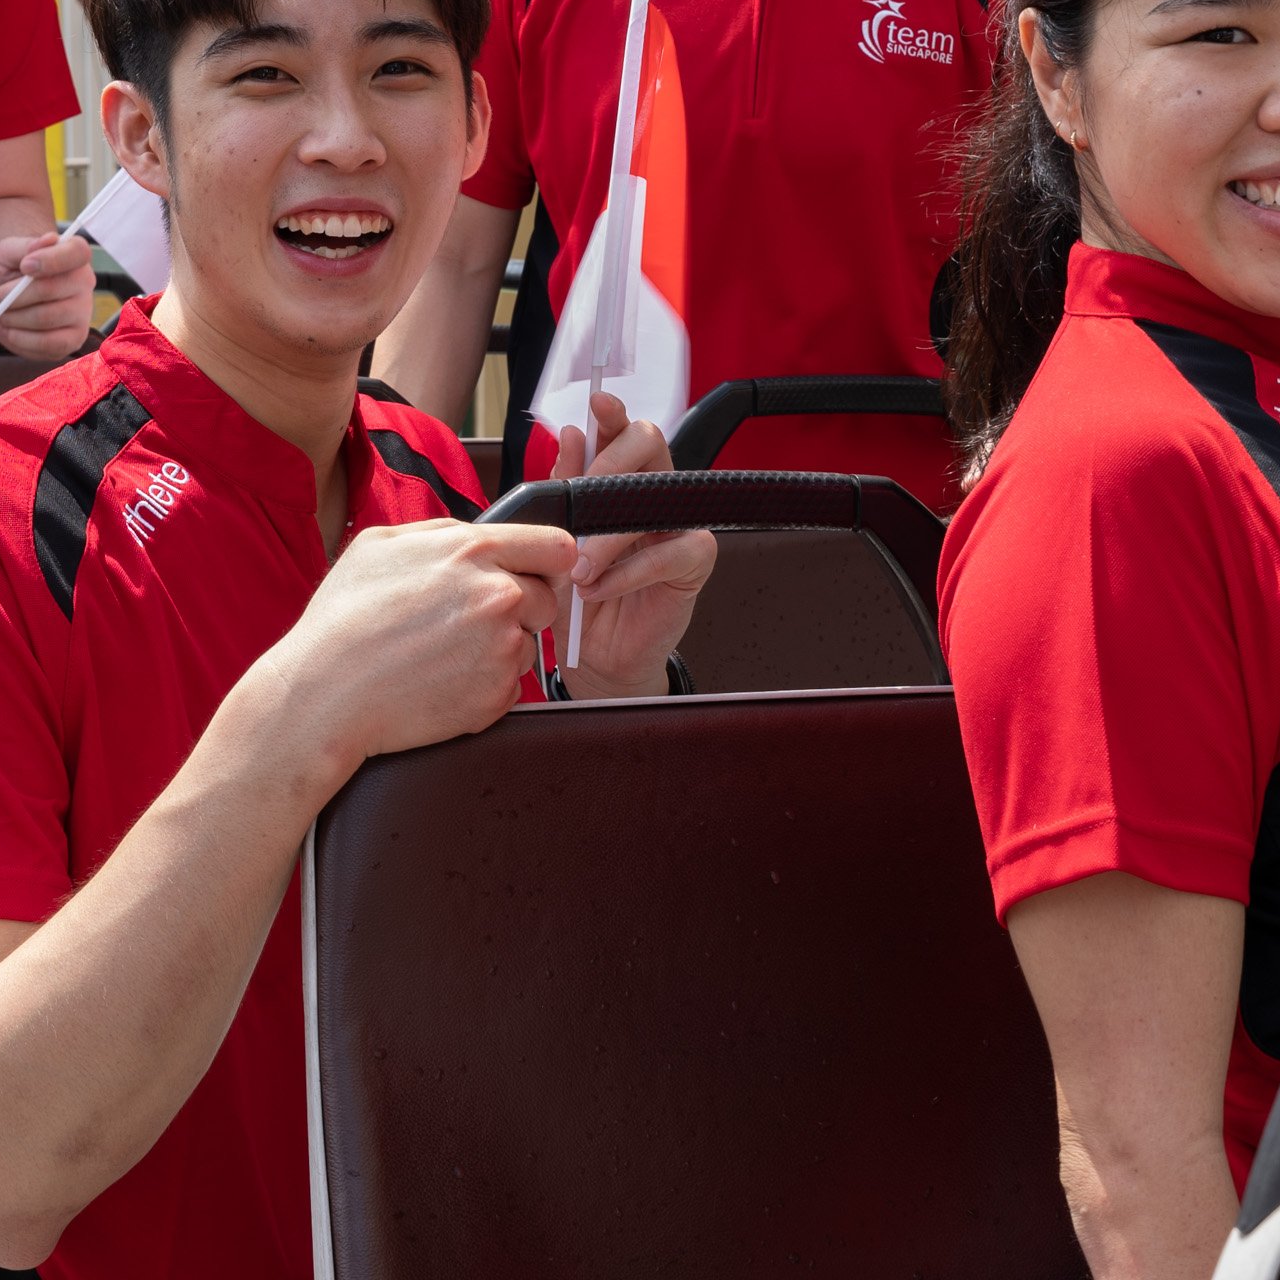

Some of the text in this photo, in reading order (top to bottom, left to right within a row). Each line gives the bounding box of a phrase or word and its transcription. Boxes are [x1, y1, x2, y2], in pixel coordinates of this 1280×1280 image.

[886, 21, 954, 54] team
[886, 42, 953, 64] SINGAPORE
[121, 461, 190, 548] thlete
